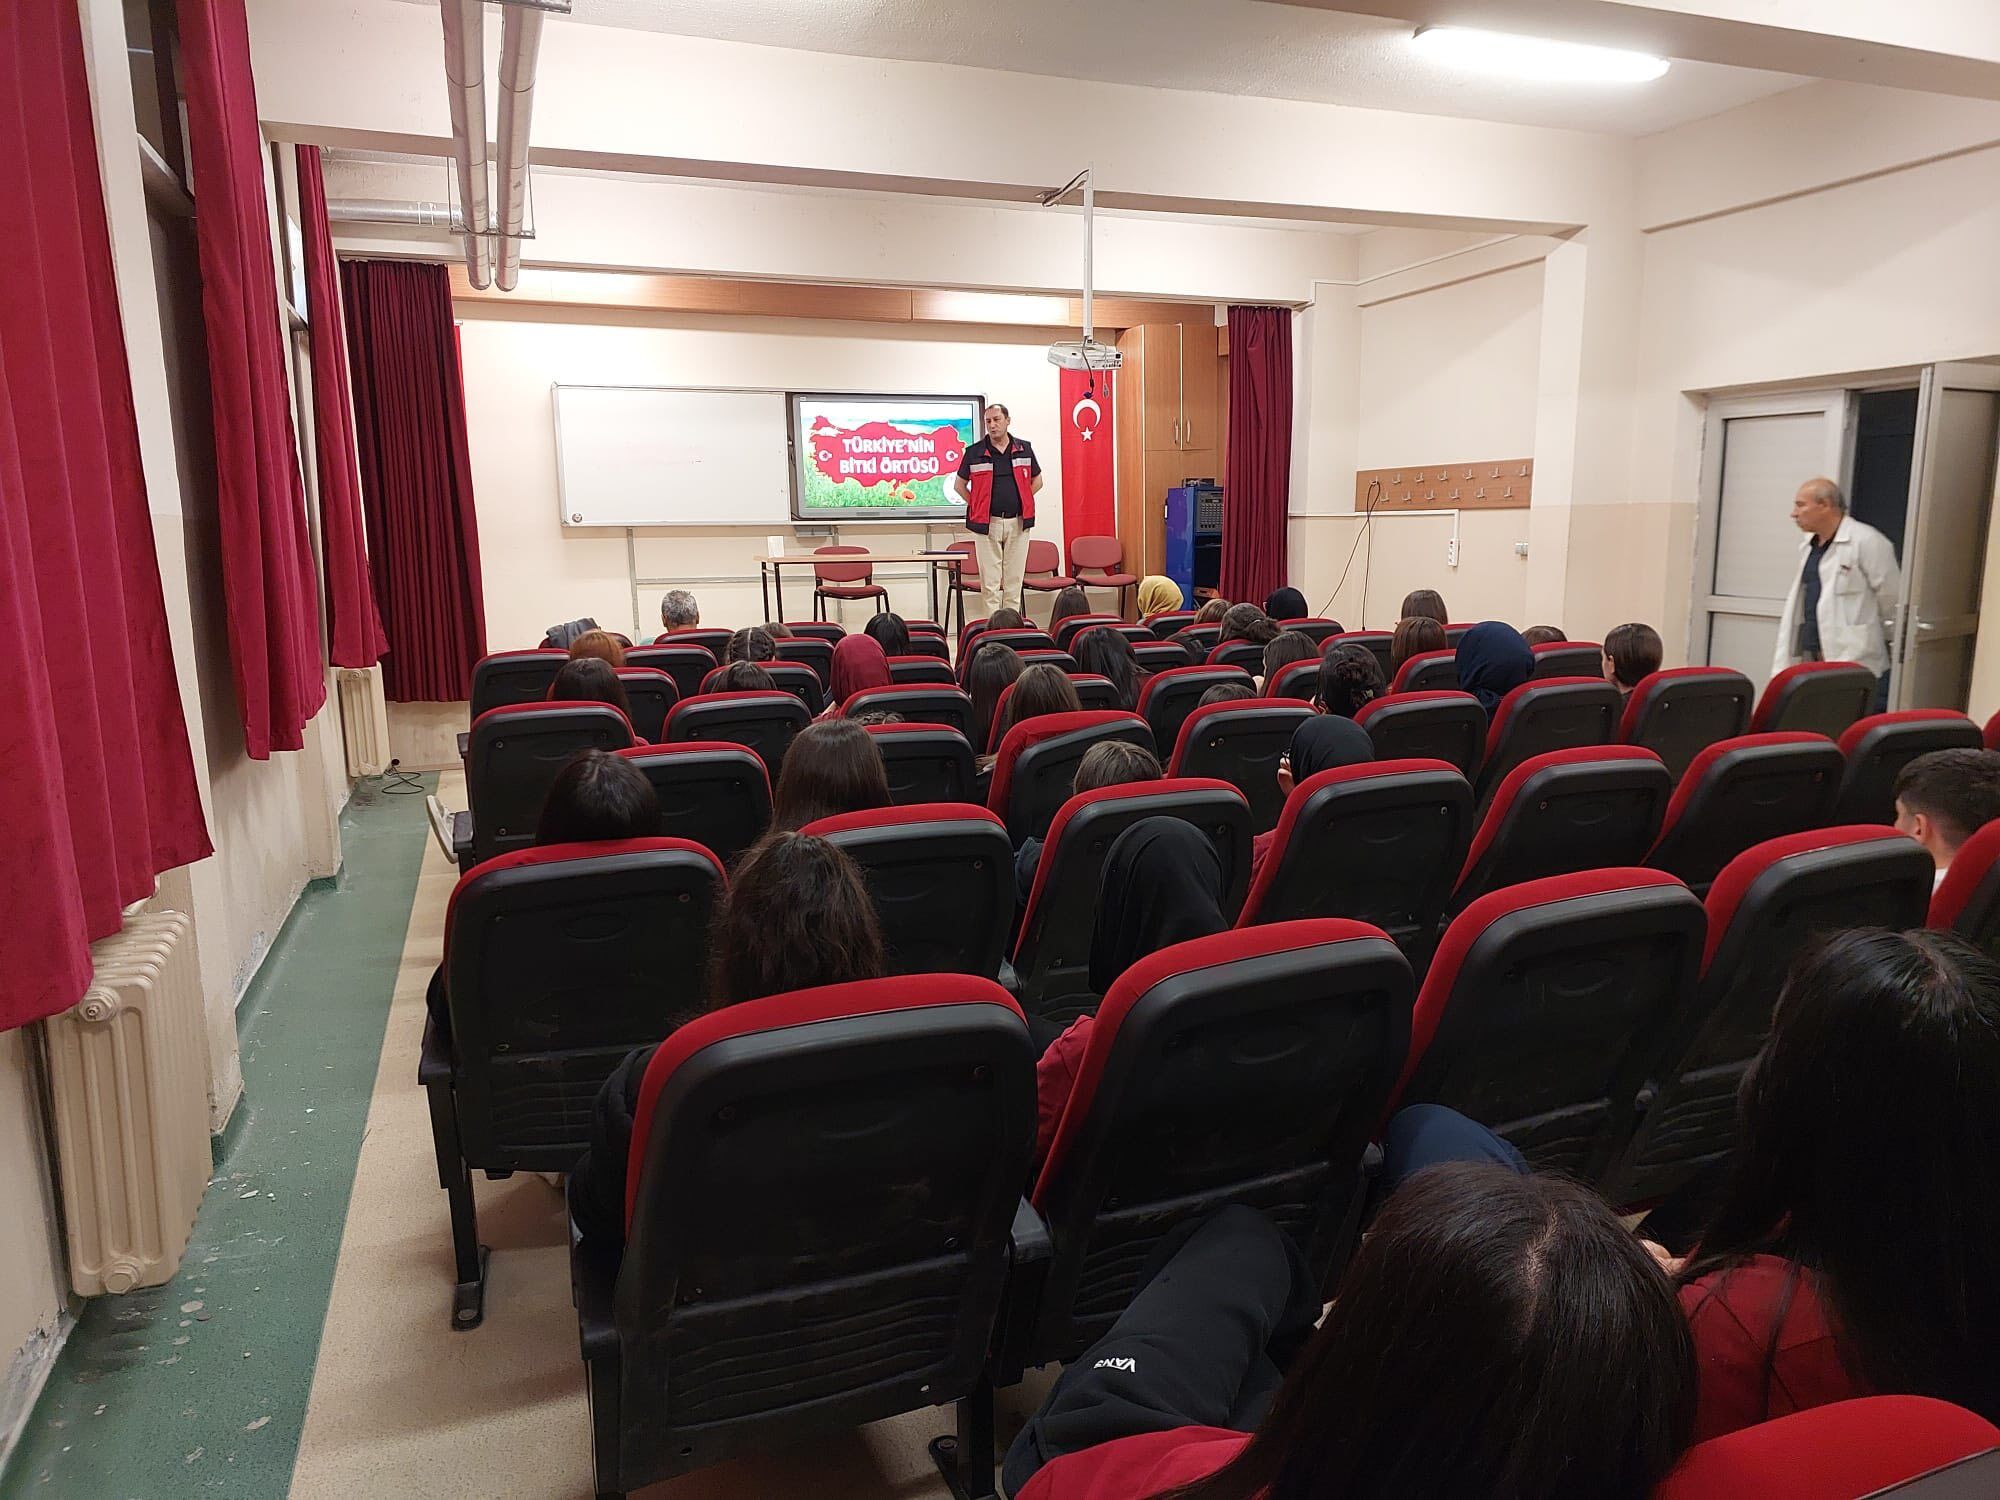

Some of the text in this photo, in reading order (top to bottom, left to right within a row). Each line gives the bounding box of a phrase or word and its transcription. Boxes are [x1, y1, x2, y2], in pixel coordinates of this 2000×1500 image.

[841, 435, 935, 454] TÜRKİYE'NİN
[839, 456, 940, 475] BİTKİ ÖRTÜSÜ
[1093, 1357, 1136, 1373] VANS
